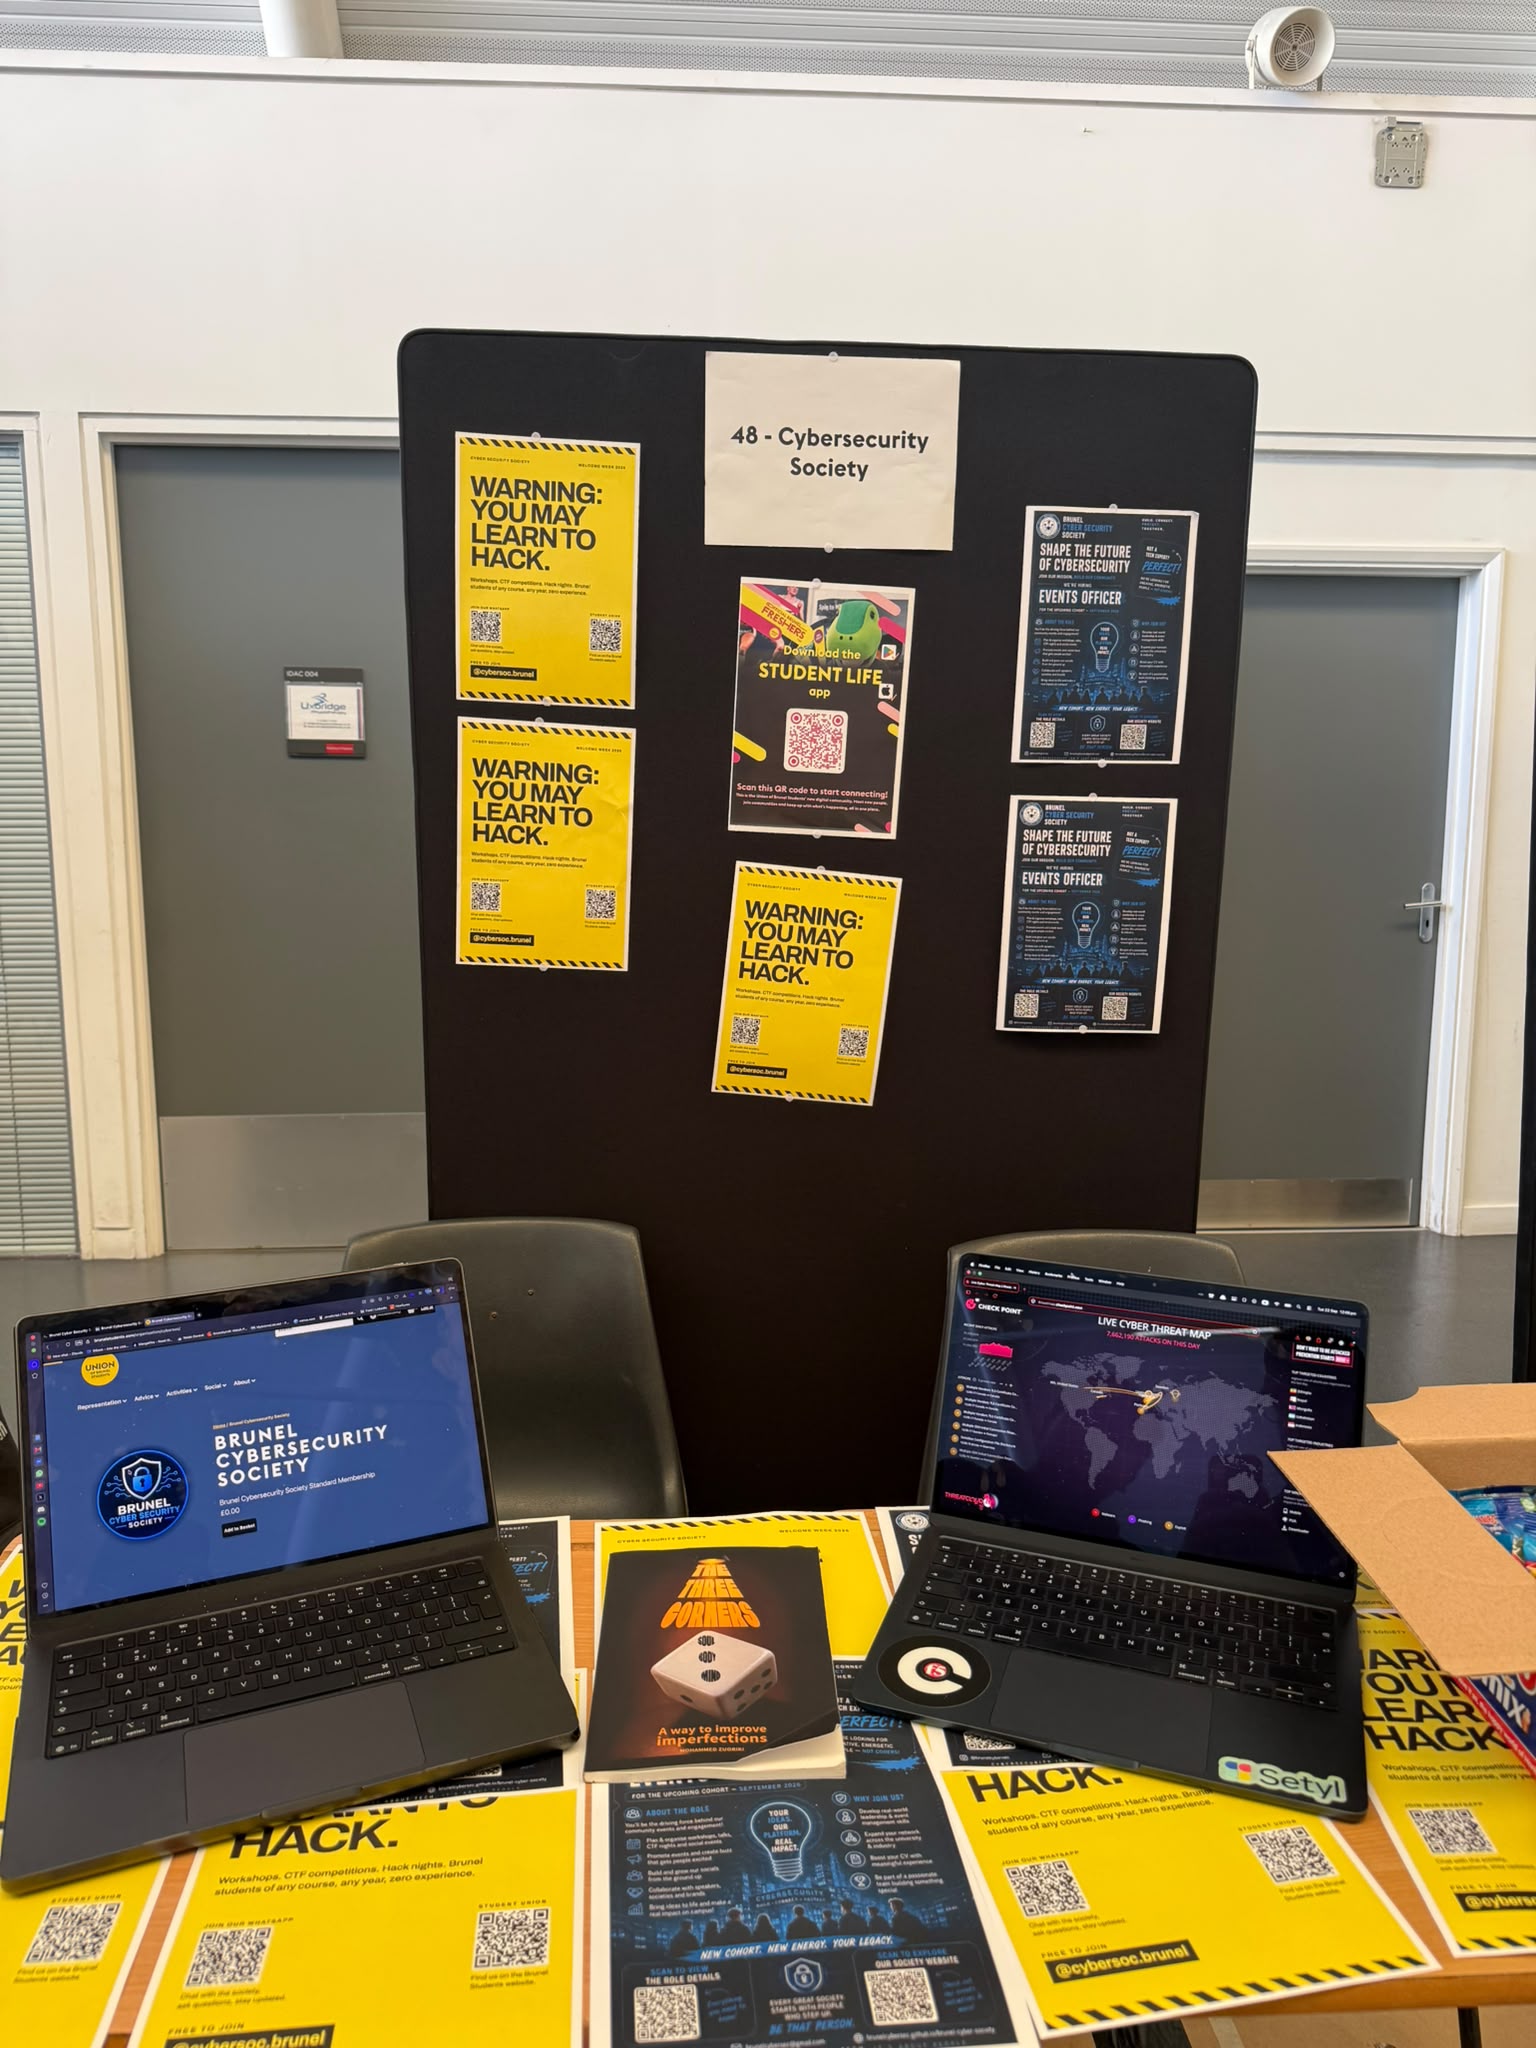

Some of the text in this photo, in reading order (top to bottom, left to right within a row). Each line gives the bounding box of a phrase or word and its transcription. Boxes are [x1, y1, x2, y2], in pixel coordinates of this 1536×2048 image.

[731, 426, 757, 444] 48
[778, 427, 929, 453] Cybersecurity
[790, 457, 868, 481] Society
[470, 476, 602, 504] WARNING:
[471, 500, 586, 526] YOU MAY
[472, 523, 596, 550] LEARN TO
[472, 546, 550, 570] HACK.
[1040, 543, 1131, 558] SHAPE THE FUTURE
[1039, 558, 1130, 573] OF CYBERSECURITY
[1142, 561, 1182, 574] PERFECT!
[1039, 590, 1122, 605] EVENTS OFFICER
[761, 606, 806, 640] FRESHERS
[783, 645, 861, 659] Download the
[473, 668, 534, 678] @cybersoc.brunel
[759, 662, 882, 685] STUDENT LIFE
[809, 688, 830, 699] app
[472, 758, 598, 784] WARNING:
[473, 780, 583, 805] YOU MAY
[737, 783, 756, 791] Scan
[758, 784, 773, 792] this
[775, 785, 787, 793] QR
[789, 786, 808, 794] code
[841, 790, 888, 799] connecting!
[473, 802, 592, 827] LEARN TO
[473, 824, 548, 845] HACK.
[1023, 829, 1112, 843] SHAPE THE FUTURE
[1022, 843, 1111, 856] OF CYBERSECURITY
[1122, 845, 1162, 858] PERFECT!
[1022, 872, 1102, 886] EVENTS OFFICER
[745, 900, 863, 929] WARNING:
[743, 921, 847, 947] YOU MAY
[741, 941, 853, 969] LEARN TO
[739, 961, 809, 985] HACK.
[978, 1303, 1021, 1315] CHECK POINT
[1098, 1316, 1211, 1340] LIVE CYBER THREAT MAP
[1135, 1335, 1160, 1344] ATTACKS
[1174, 1340, 1186, 1348] THIS
[1188, 1342, 1200, 1350] DAY
[85, 1361, 115, 1372] UNION
[77, 1399, 122, 1411] Representation
[135, 1394, 154, 1402] Advice
[167, 1388, 192, 1397] Activities
[205, 1383, 221, 1391] Social
[215, 1423, 297, 1450] BRUNEL
[216, 1425, 387, 1468] CYBERSECURITY
[218, 1457, 309, 1487] SOCIETY
[219, 1472, 375, 1506] Brunel Cybersecurity Society Standard Membership
[109, 1506, 180, 1525] CYBER SECURITY
[118, 1498, 171, 1515] BRUNEL
[221, 1507, 240, 1516] £0.00
[128, 1517, 163, 1528] SOCIETY
[692, 1564, 731, 1577] THE
[678, 1579, 744, 1599] THREE
[661, 1601, 761, 1628] CORNERS
[698, 1635, 715, 1646] SOUL
[699, 1651, 716, 1663] BODY
[701, 1670, 721, 1682] MIND
[716, 1725, 767, 1734] improve
[657, 1734, 767, 1747] imperfections
[663, 1789, 699, 1797] UPCOMING
[739, 1783, 781, 1792] SEPTEMBER
[967, 1767, 1123, 1803] HACK.
[1260, 1768, 1340, 1799] Setyl
[982, 1786, 1214, 1826] Workshops. CTF competitions. Hack nights. Brunel
[987, 1800, 1214, 1836] students of any course, any year, zero experience.
[230, 1819, 399, 1859] HACK.
[764, 1830, 801, 1838] PLATFORM.
[772, 1844, 799, 1853] IMPACT.
[700, 1935, 893, 1960] NEW COHORT. NEW ENERGY. YOUR LEGACY.
[875, 1956, 959, 1969] OUR SOCIETY WEBSITE
[1055, 1944, 1190, 1979] @cybersoc.brunel
[645, 1972, 721, 1985] THE ROLE DETAILS
